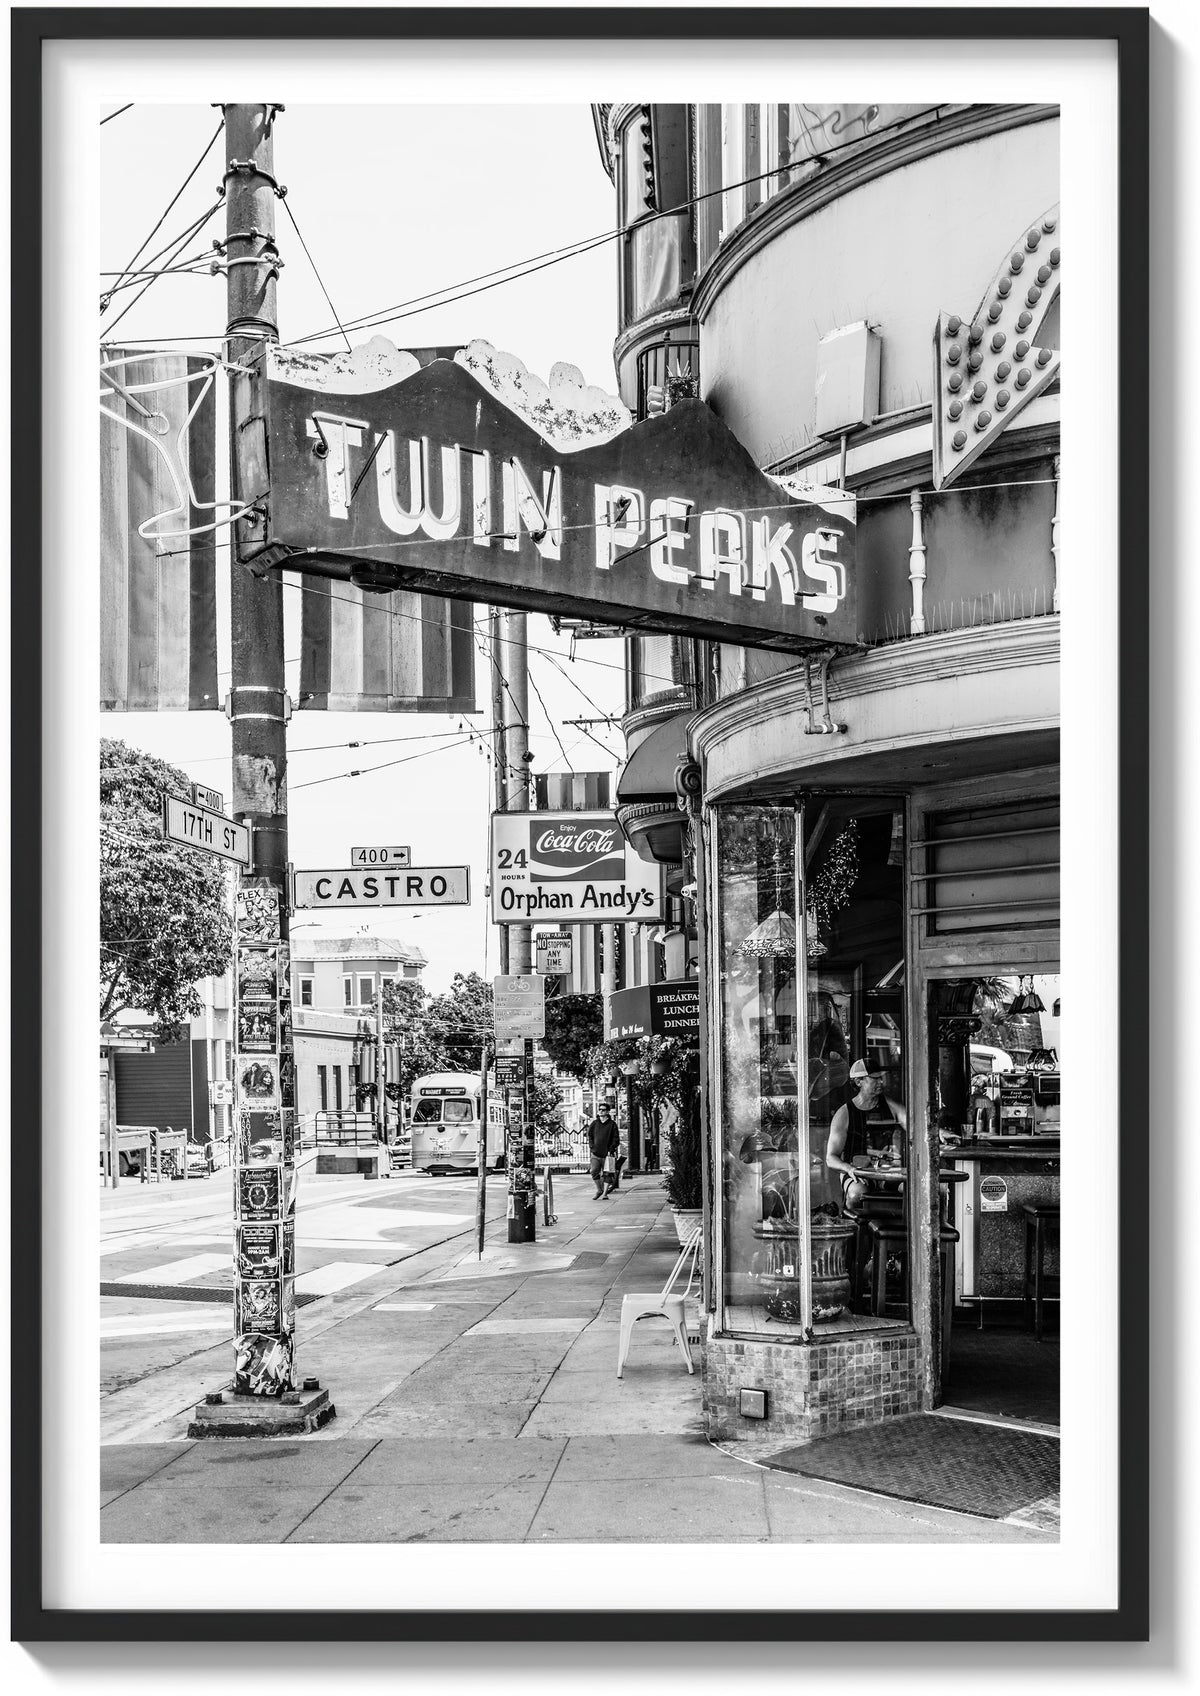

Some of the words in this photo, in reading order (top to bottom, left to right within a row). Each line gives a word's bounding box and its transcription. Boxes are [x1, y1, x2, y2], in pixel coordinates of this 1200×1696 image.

[306, 410, 562, 561] TWIN
[595, 482, 846, 613] PEAKS
[205, 791, 220, 810] 4000
[182, 810, 213, 844] 17TH
[223, 828, 238, 852] ST
[560, 824, 577, 832] Enjoy
[536, 828, 618, 854] Coca-Cola
[358, 849, 388, 863] 400
[497, 848, 529, 869] 24
[315, 875, 448, 900] CASTRO
[237, 889, 261, 901] FLEX
[501, 886, 574, 916] Orphan
[580, 884, 655, 915] Andy's
[537, 939, 547, 949] NO
[547, 940, 571, 949] STOPPING
[547, 950, 561, 958] ANY
[546, 958, 562, 966] TIME
[656, 993, 700, 1003] BREAKFA
[663, 1004, 700, 1015] LUNCH
